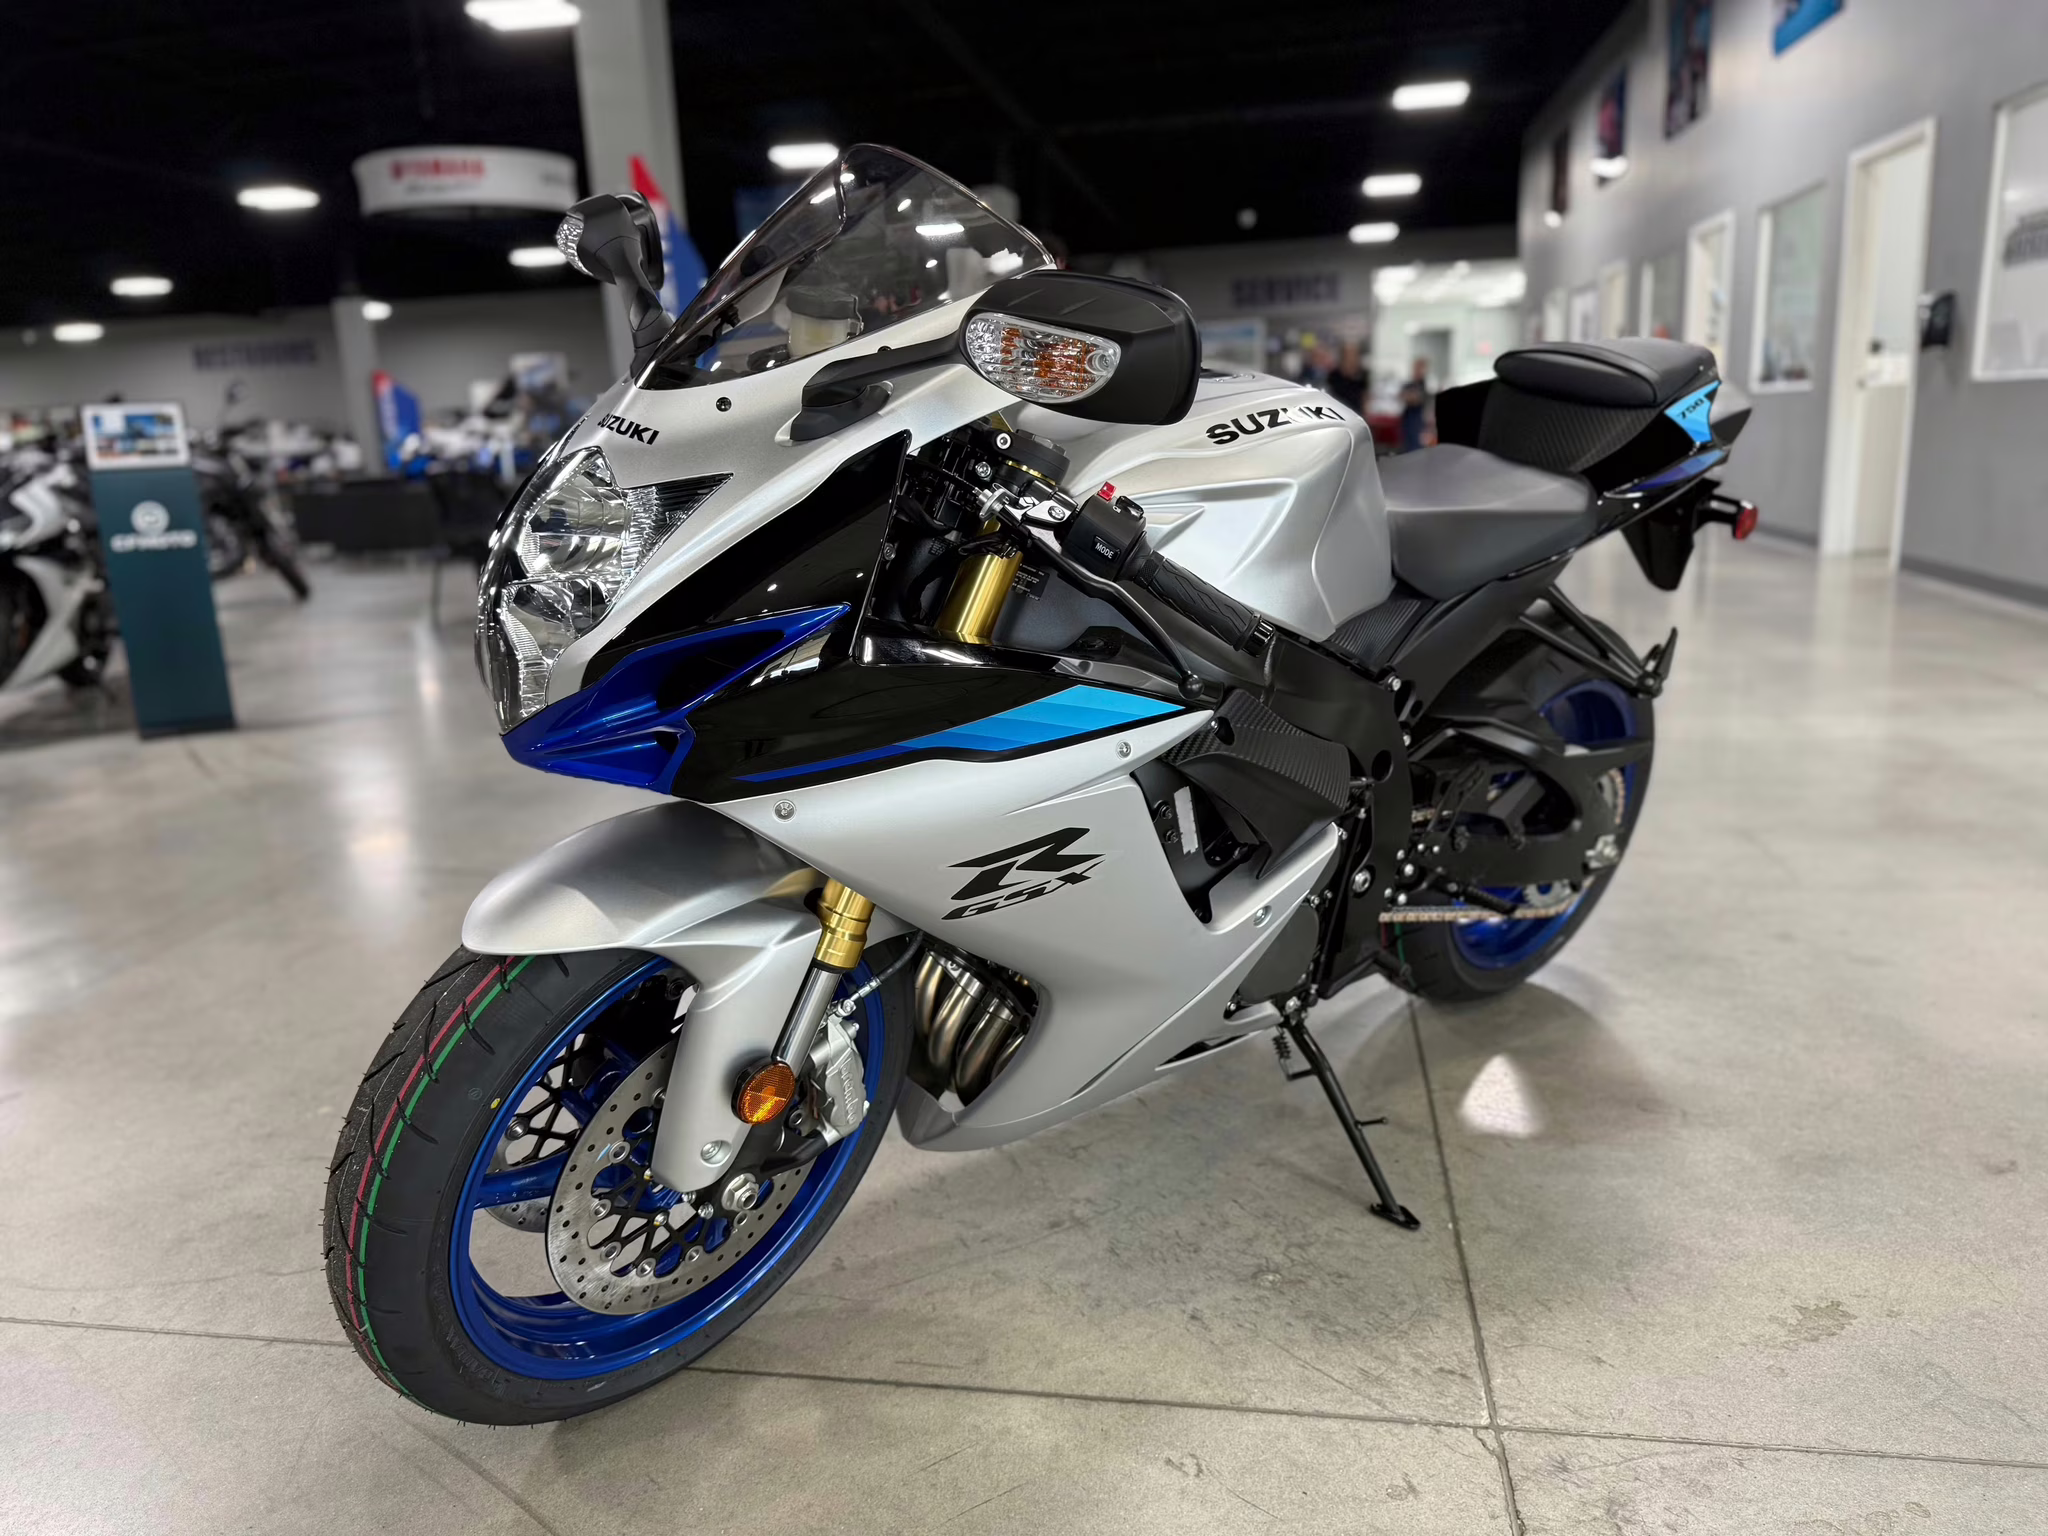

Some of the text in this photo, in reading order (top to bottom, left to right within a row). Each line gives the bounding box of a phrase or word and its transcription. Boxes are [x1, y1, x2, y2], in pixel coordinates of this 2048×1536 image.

[1676, 398, 1705, 419] 750
[1095, 542, 1115, 559] MODE
[941, 860, 1106, 920] GSX
[840, 1057, 858, 1125] brembo
